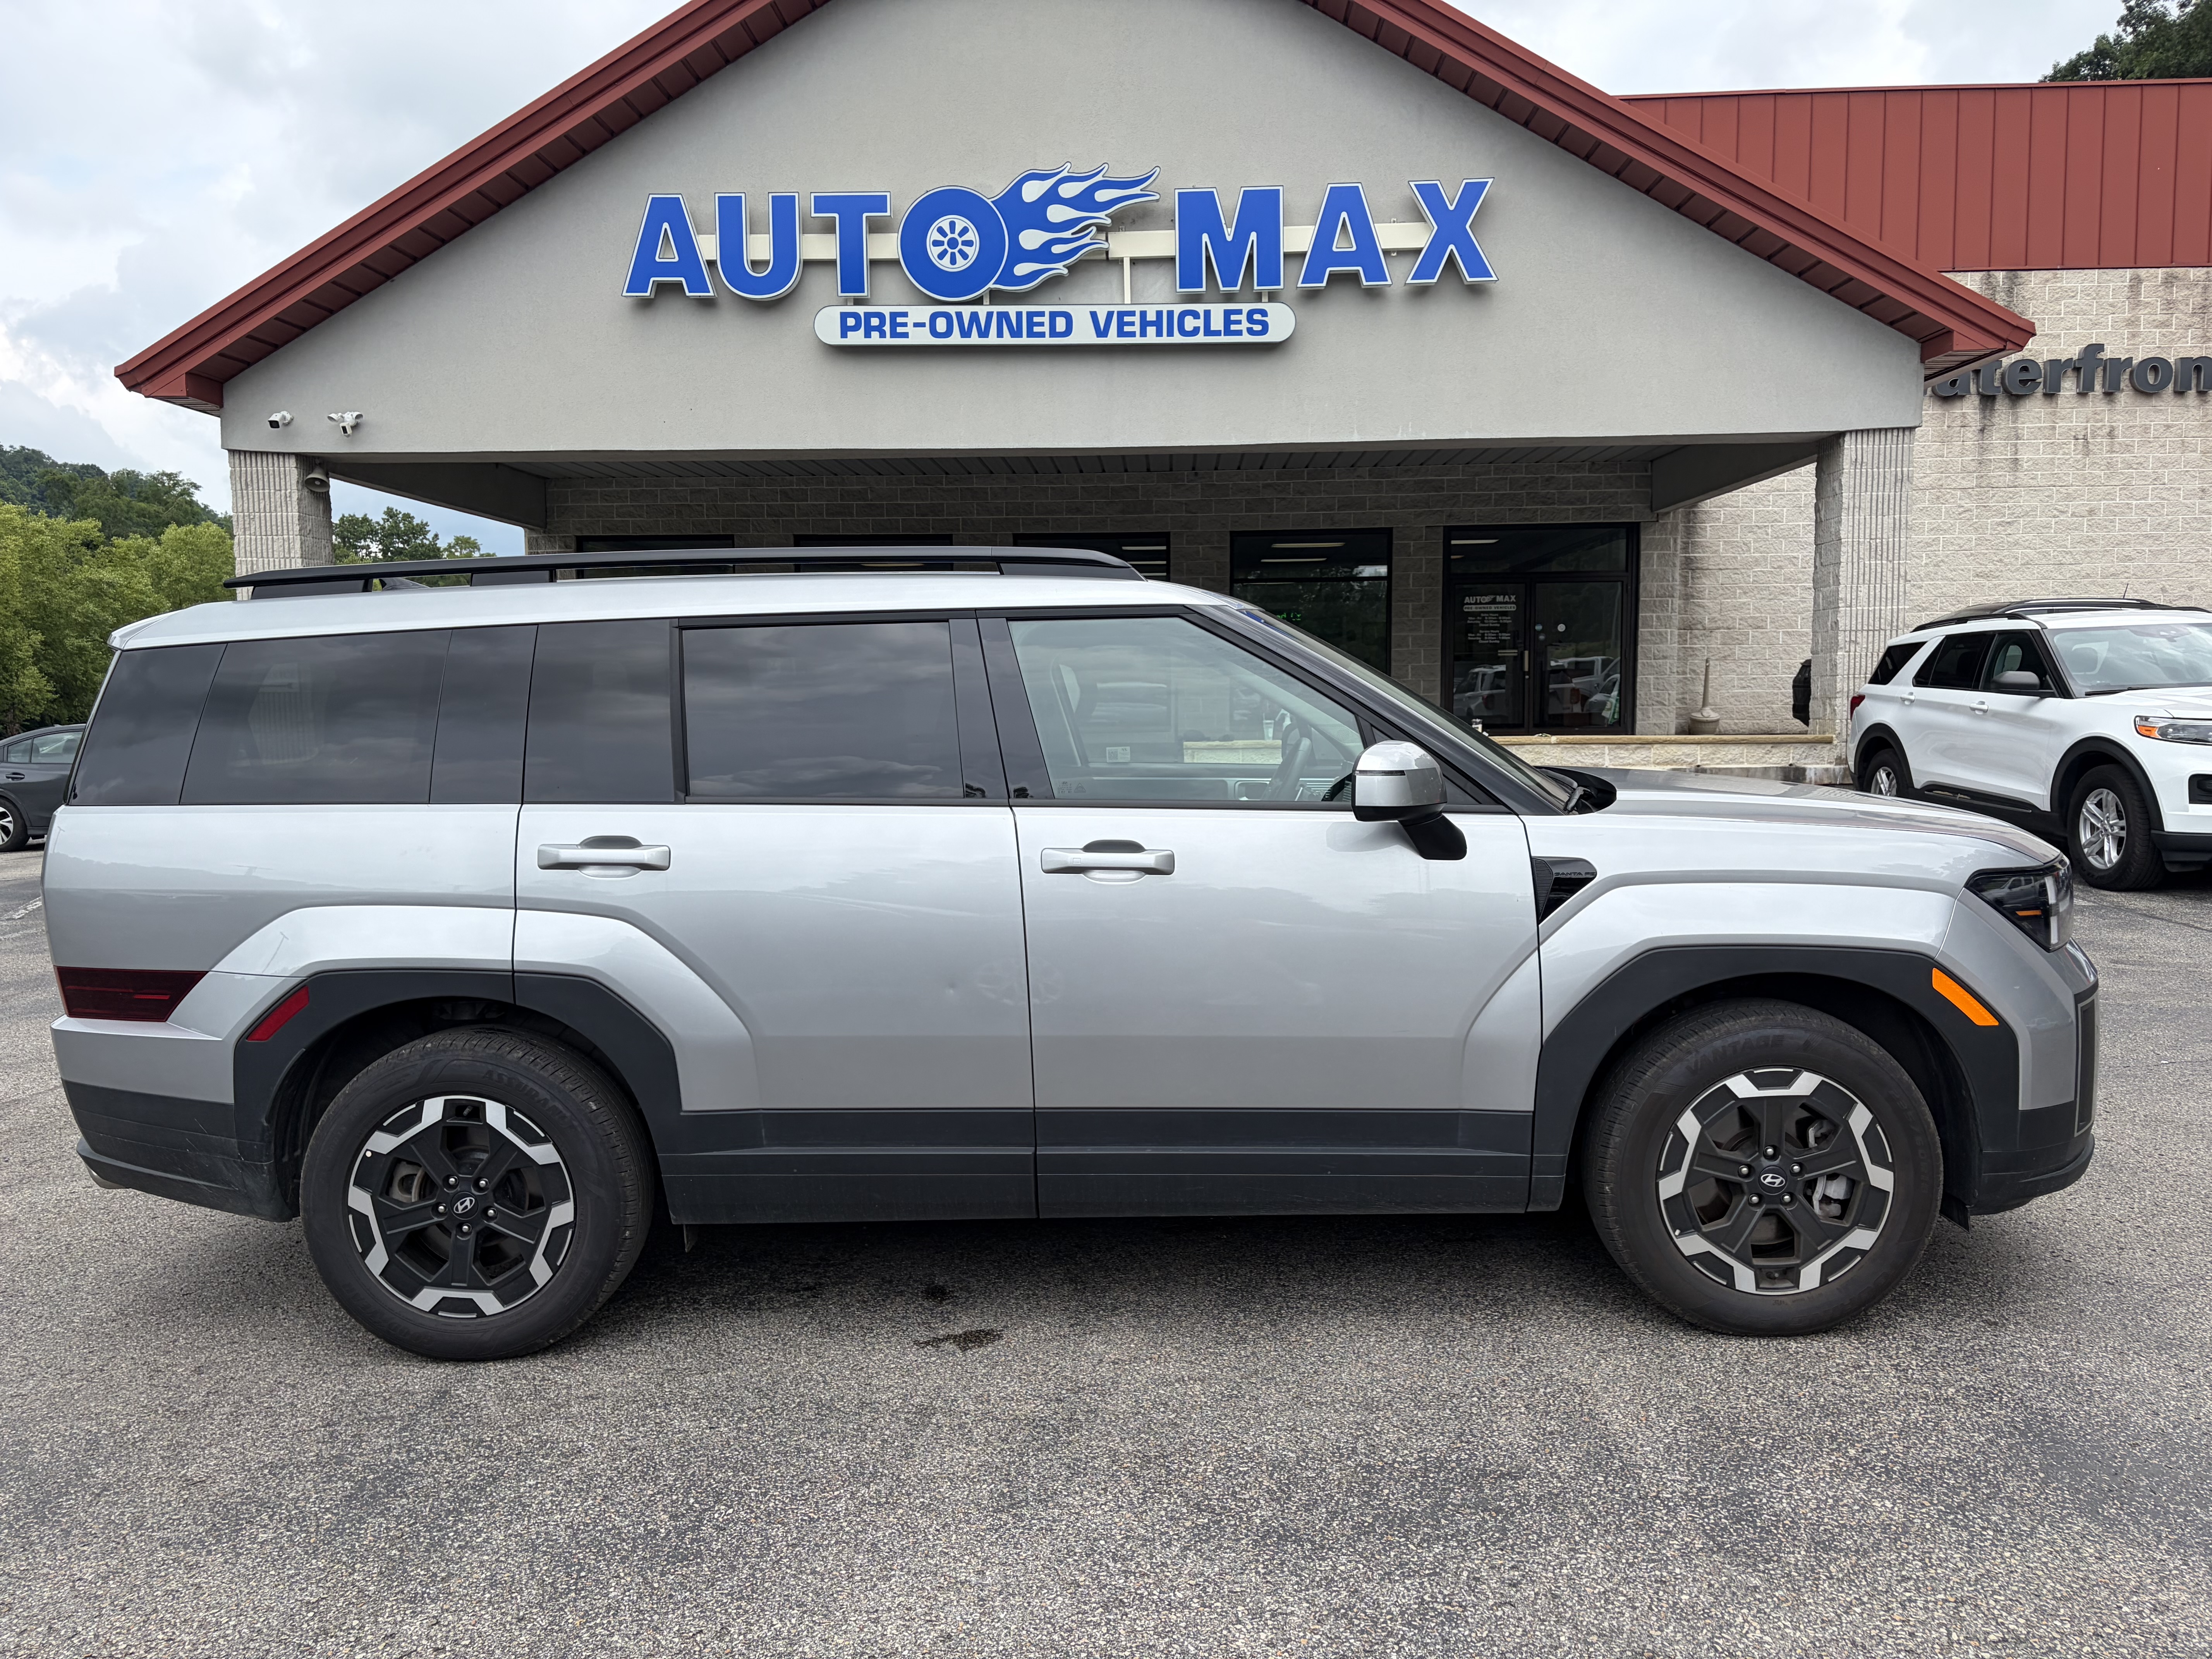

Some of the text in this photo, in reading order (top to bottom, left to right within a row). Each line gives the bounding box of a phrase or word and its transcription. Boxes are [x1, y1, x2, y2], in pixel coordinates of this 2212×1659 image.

[621, 177, 1499, 302] AUTO MAX
[839, 308, 1269, 339] PRE-OWNED VEHICLES
[1923, 343, 2212, 397] aterfron
[1683, 1035, 1785, 1077] VANTAGE
[481, 1068, 580, 1137] ASSURANCE
